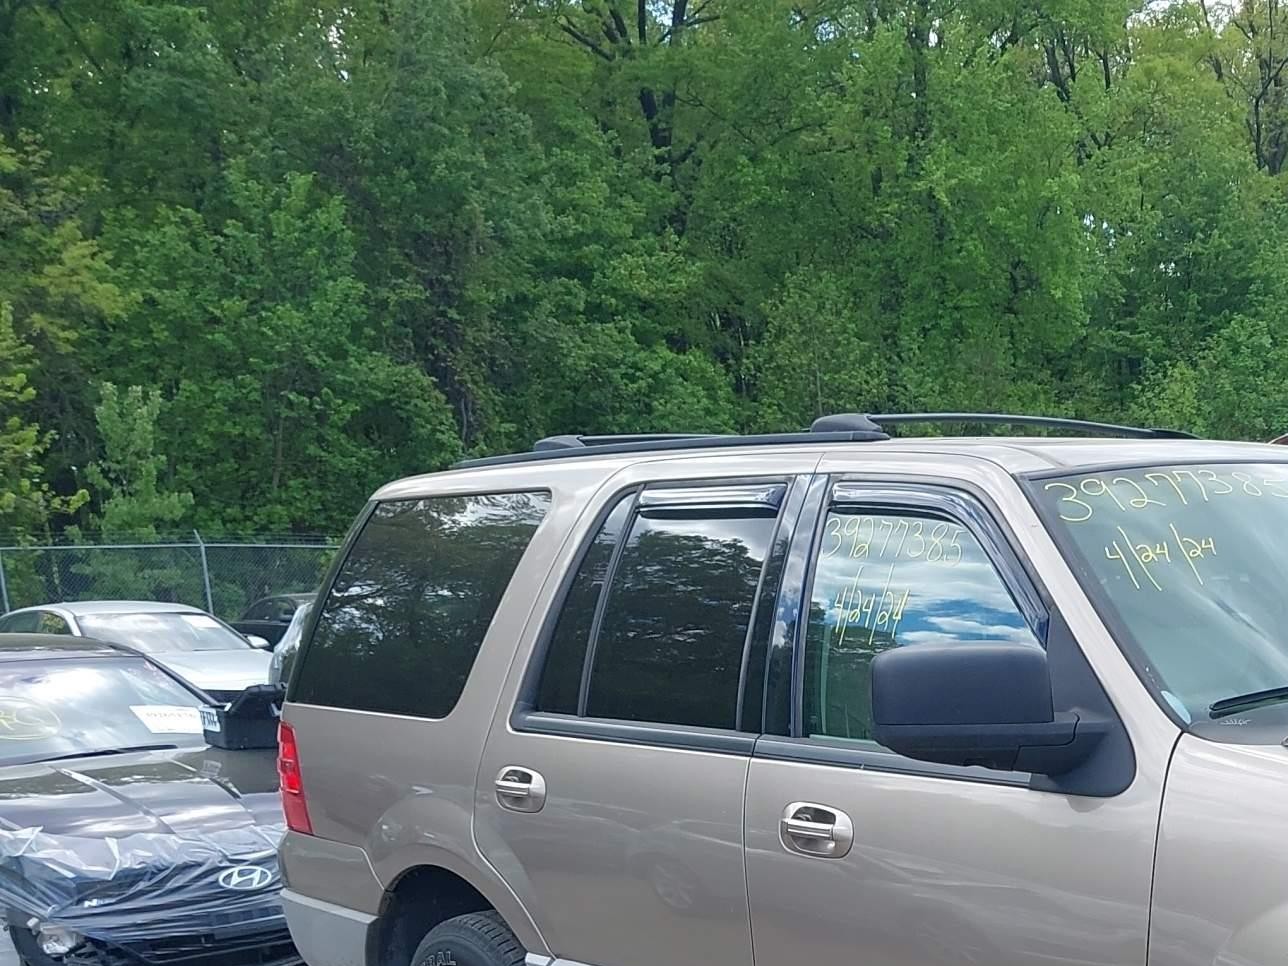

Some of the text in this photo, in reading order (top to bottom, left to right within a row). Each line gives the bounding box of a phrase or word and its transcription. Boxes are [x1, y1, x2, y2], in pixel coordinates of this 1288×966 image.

[822, 516, 967, 567] 39277385
[1104, 523, 1217, 592] 4/24/24
[835, 562, 910, 646] 4/24/24
